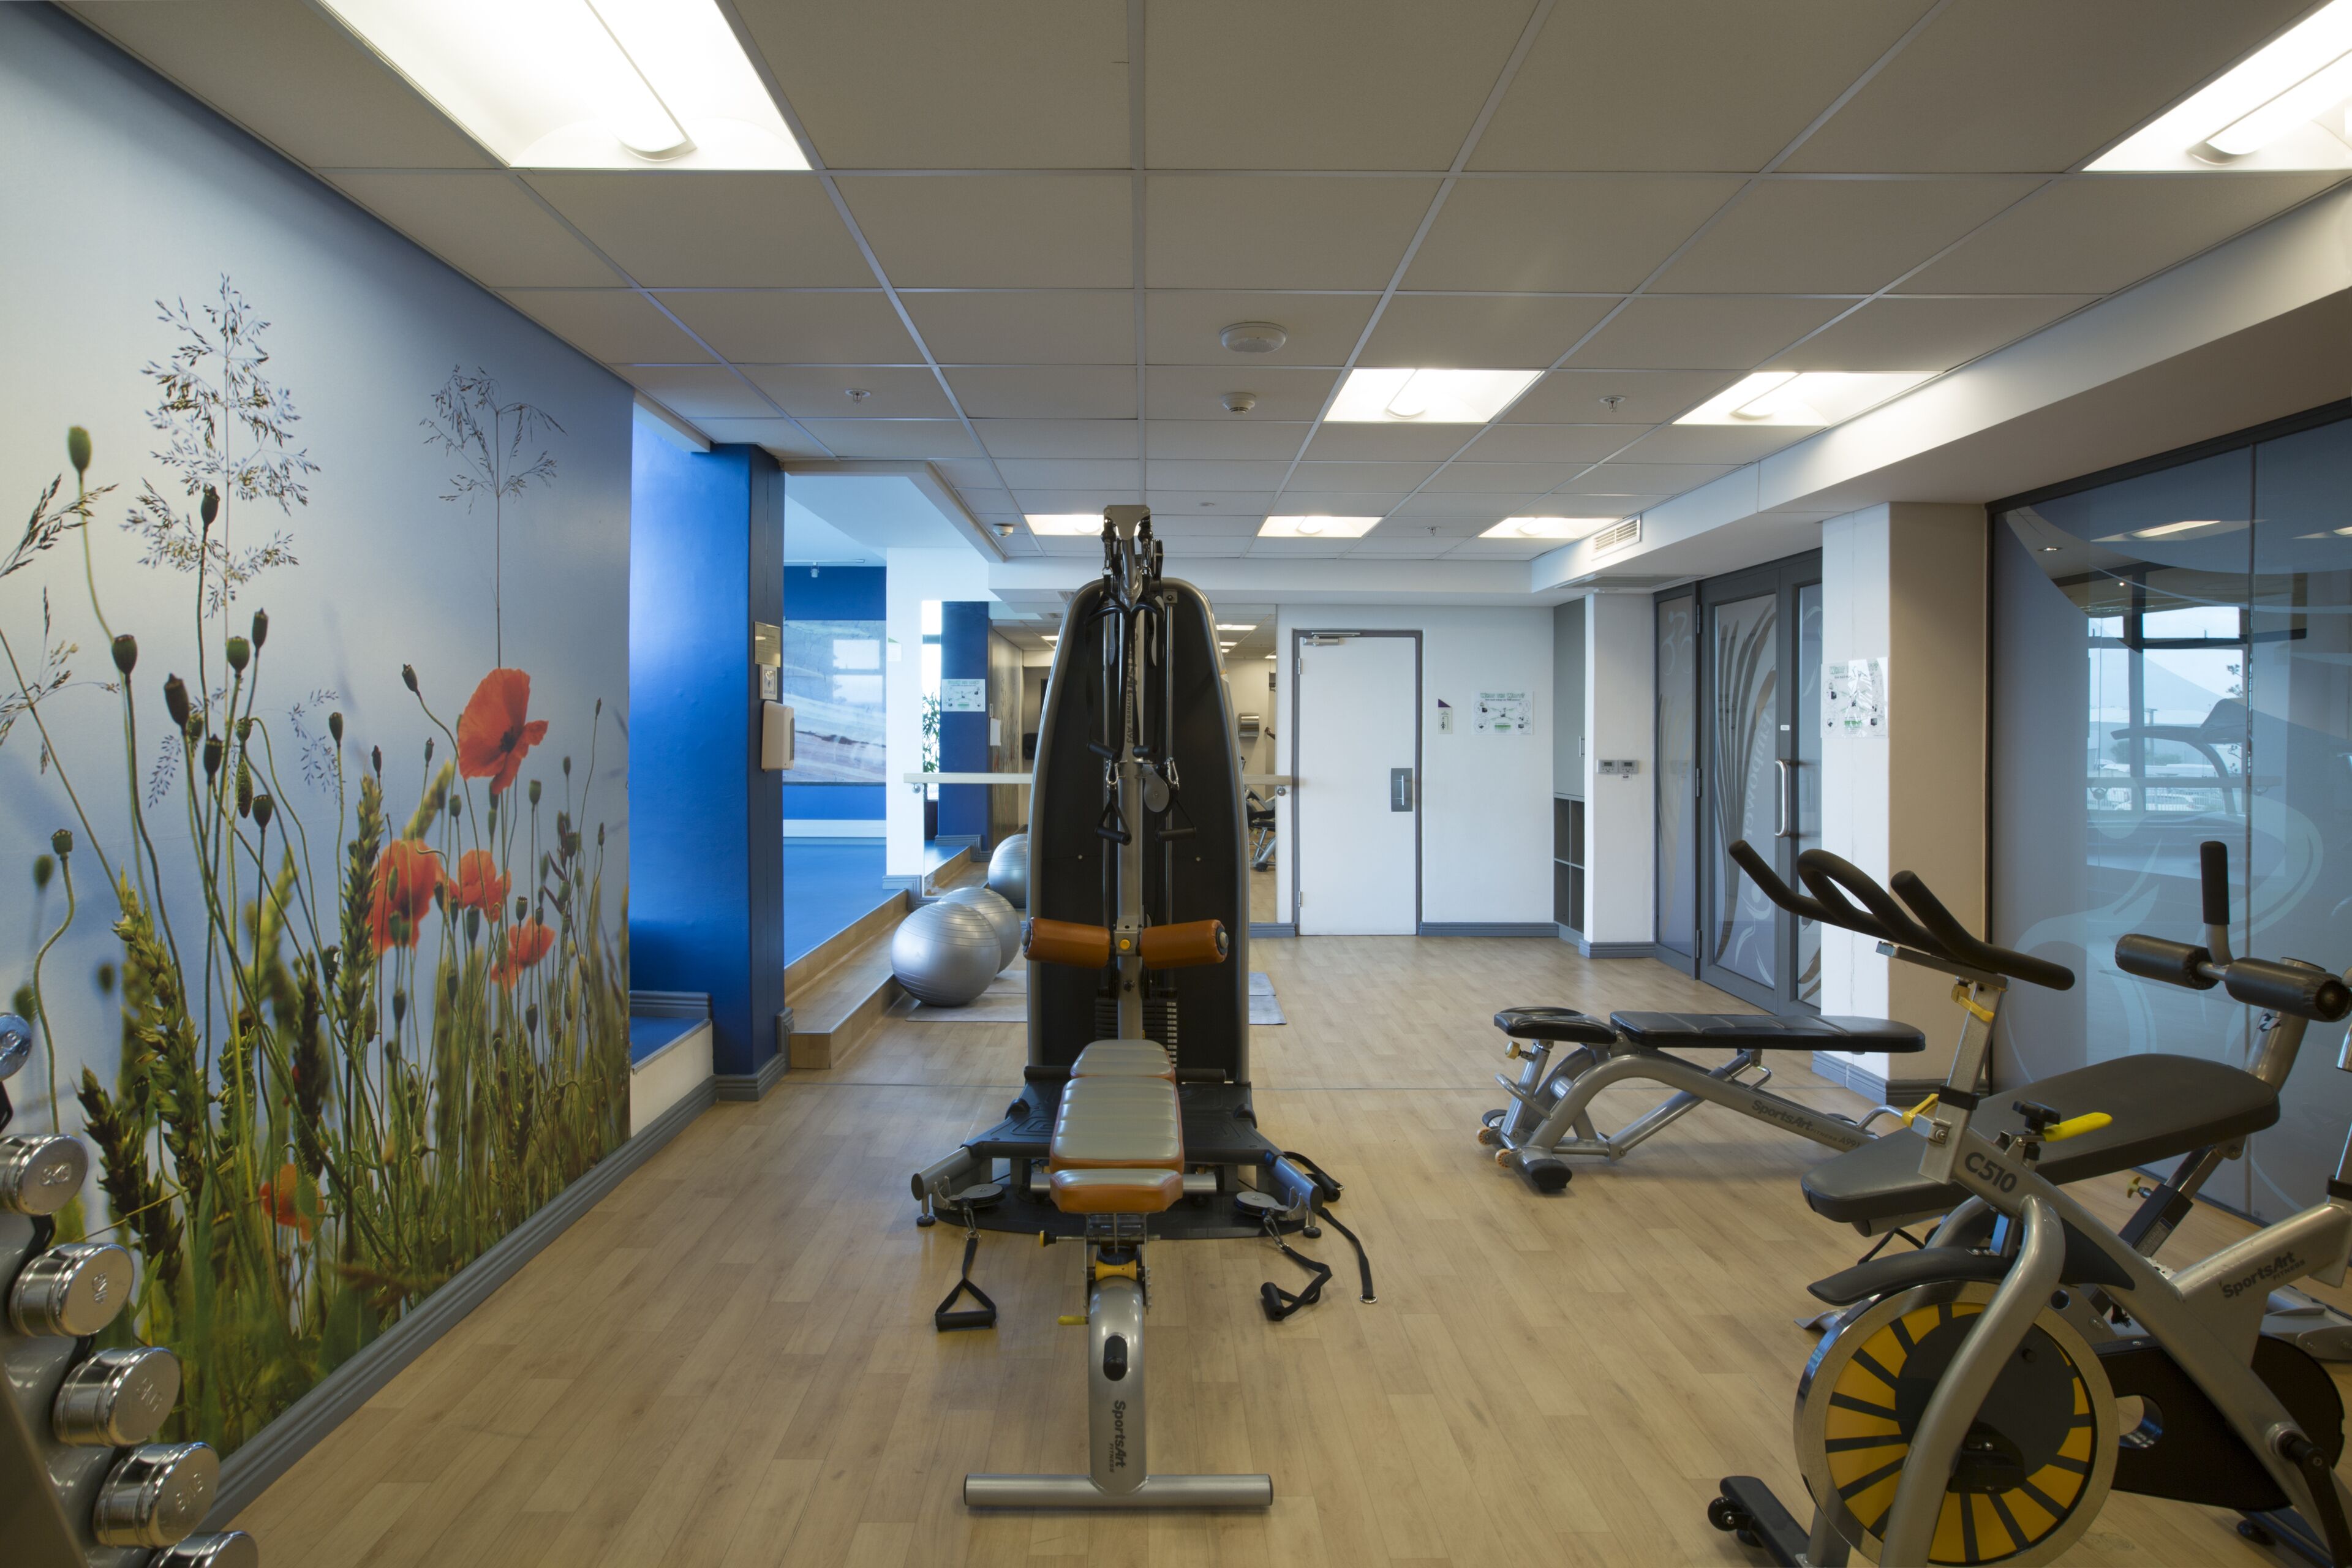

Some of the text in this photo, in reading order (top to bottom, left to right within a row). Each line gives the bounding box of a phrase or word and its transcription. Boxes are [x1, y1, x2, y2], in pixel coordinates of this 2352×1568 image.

[1752, 1100, 1812, 1131] SportsArt
[1810, 1127, 1838, 1142] FITNESS
[1965, 1152, 2017, 1193] C510
[2222, 1251, 2296, 1298] SportsArt
[2272, 1259, 2305, 1281] FITNESS
[1112, 1400, 1126, 1468] SportsArt
